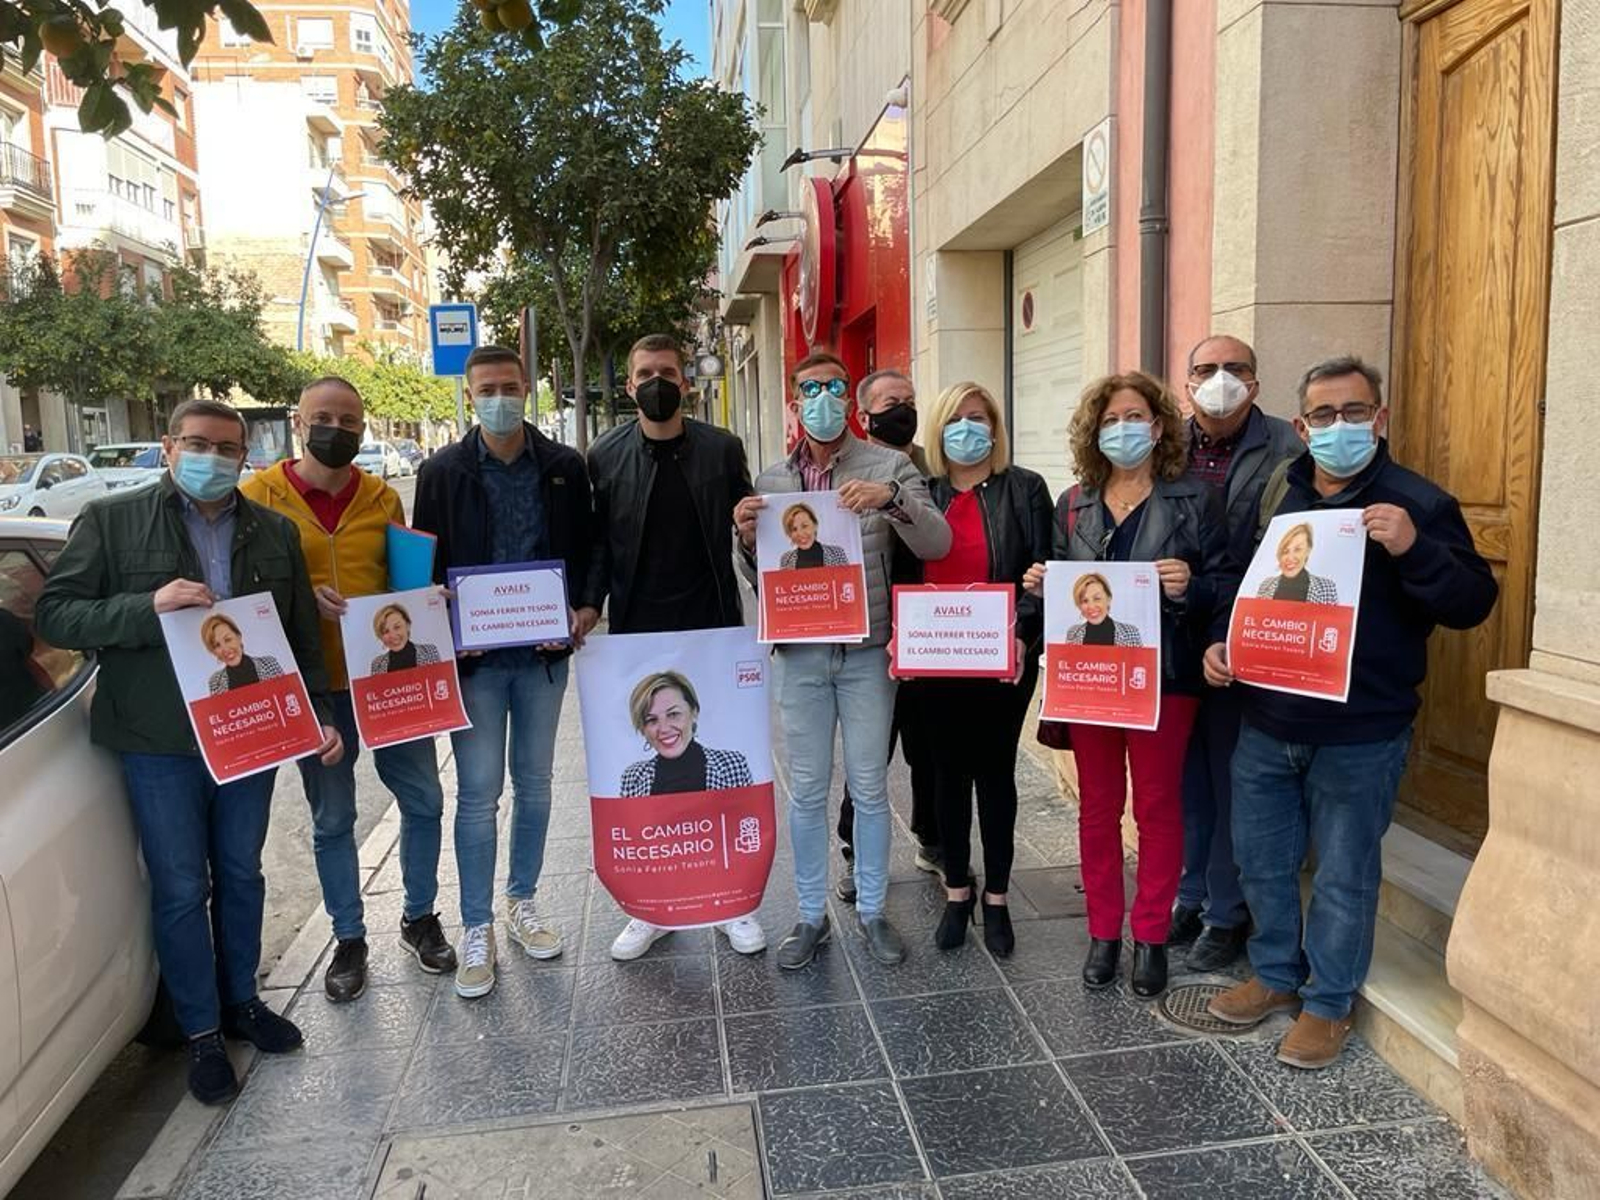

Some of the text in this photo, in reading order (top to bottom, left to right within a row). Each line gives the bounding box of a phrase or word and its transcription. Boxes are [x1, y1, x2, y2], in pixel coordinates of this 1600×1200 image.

[494, 583, 532, 596] AVALES
[775, 583, 829, 594] EL CAMBIO
[776, 592, 831, 605] NECESARIO
[470, 603, 558, 617] SONIA FERRER TESORO
[934, 605, 973, 617] AVALES
[471, 618, 559, 632] EL CAMBIO NECESARIO
[1244, 616, 1307, 632] EL CAMBIO
[935, 630, 966, 640] FERRER
[967, 631, 999, 640] TESORO
[1242, 629, 1306, 645] NECESARIO
[907, 647, 999, 656] EL CAMBIO NECESARIO
[1058, 660, 1118, 672] EL CAMBIO
[739, 672, 761, 683] PSOE
[1058, 671, 1118, 684] NECESARIO
[366, 682, 423, 702] EL CAMBIO
[368, 693, 424, 713] NECESARIO
[208, 699, 272, 726] EL CAMBIO
[212, 710, 275, 737] NECESARIO
[611, 819, 713, 841] EL CAMBIO
[613, 838, 714, 860] NECESARIO
[614, 865, 643, 874] Sonia
[682, 859, 716, 870] Tesoro
